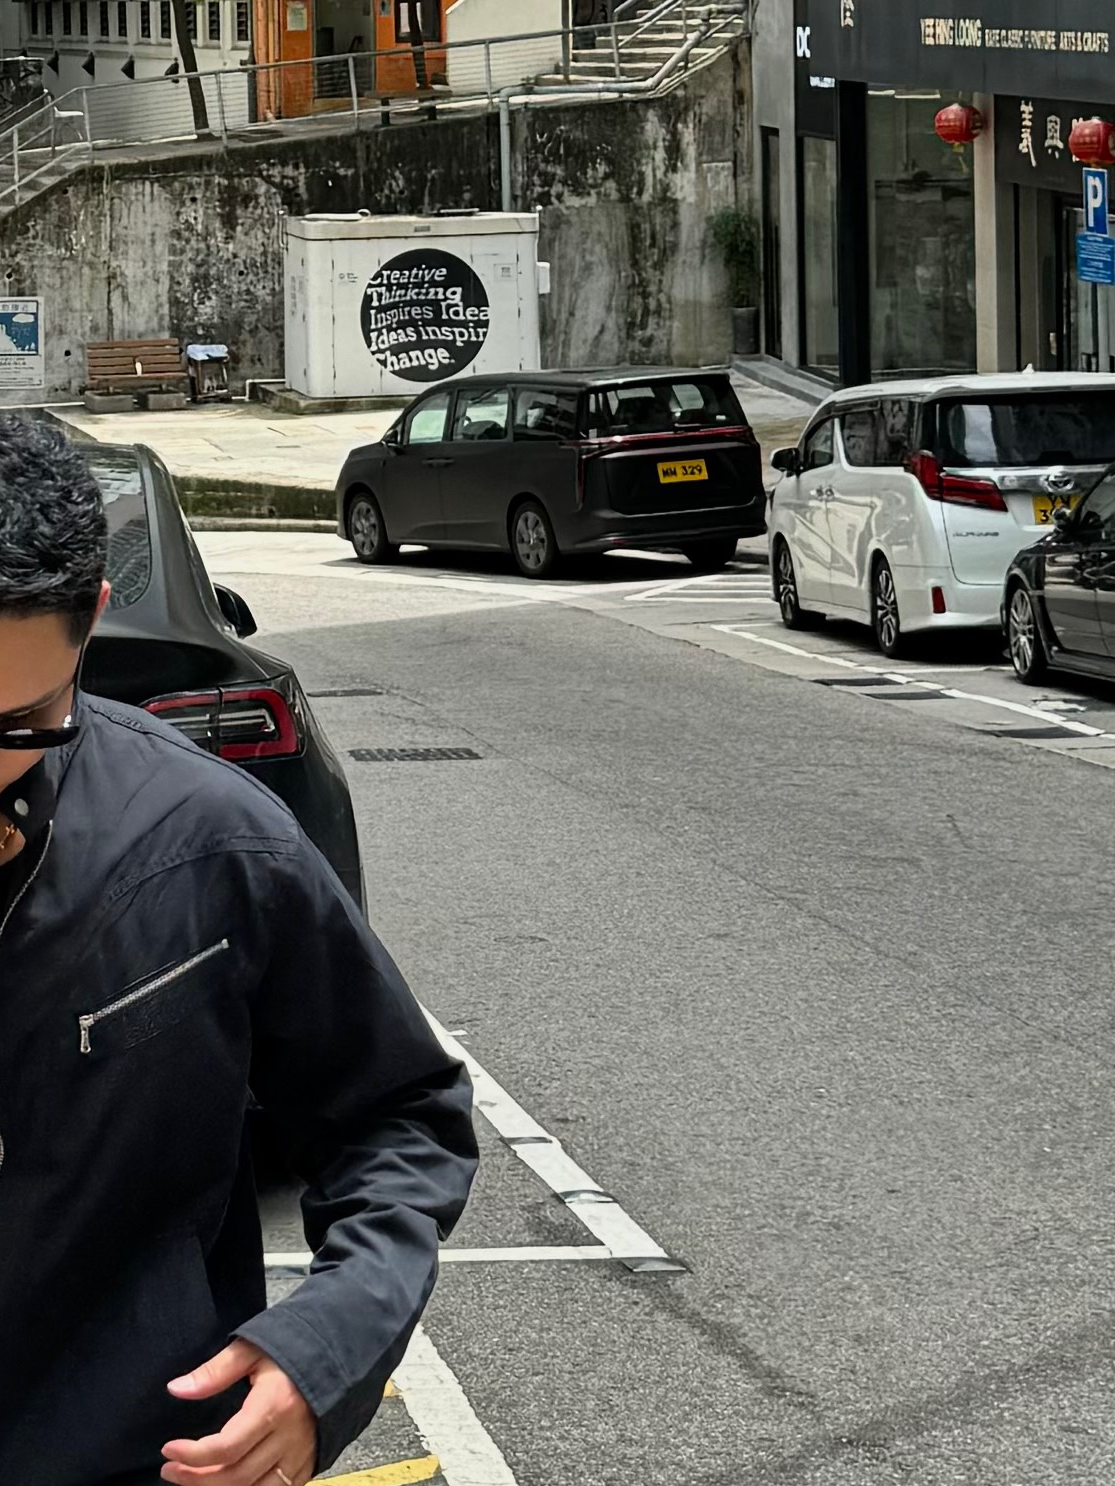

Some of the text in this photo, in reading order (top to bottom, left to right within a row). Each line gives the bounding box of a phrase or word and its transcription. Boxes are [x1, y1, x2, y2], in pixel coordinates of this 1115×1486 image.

[954, 18, 982, 47] LOONG
[1087, 176, 1103, 227] P
[366, 284, 462, 307] Thinking
[370, 303, 433, 328] Inspires
[369, 326, 417, 351] Ideas
